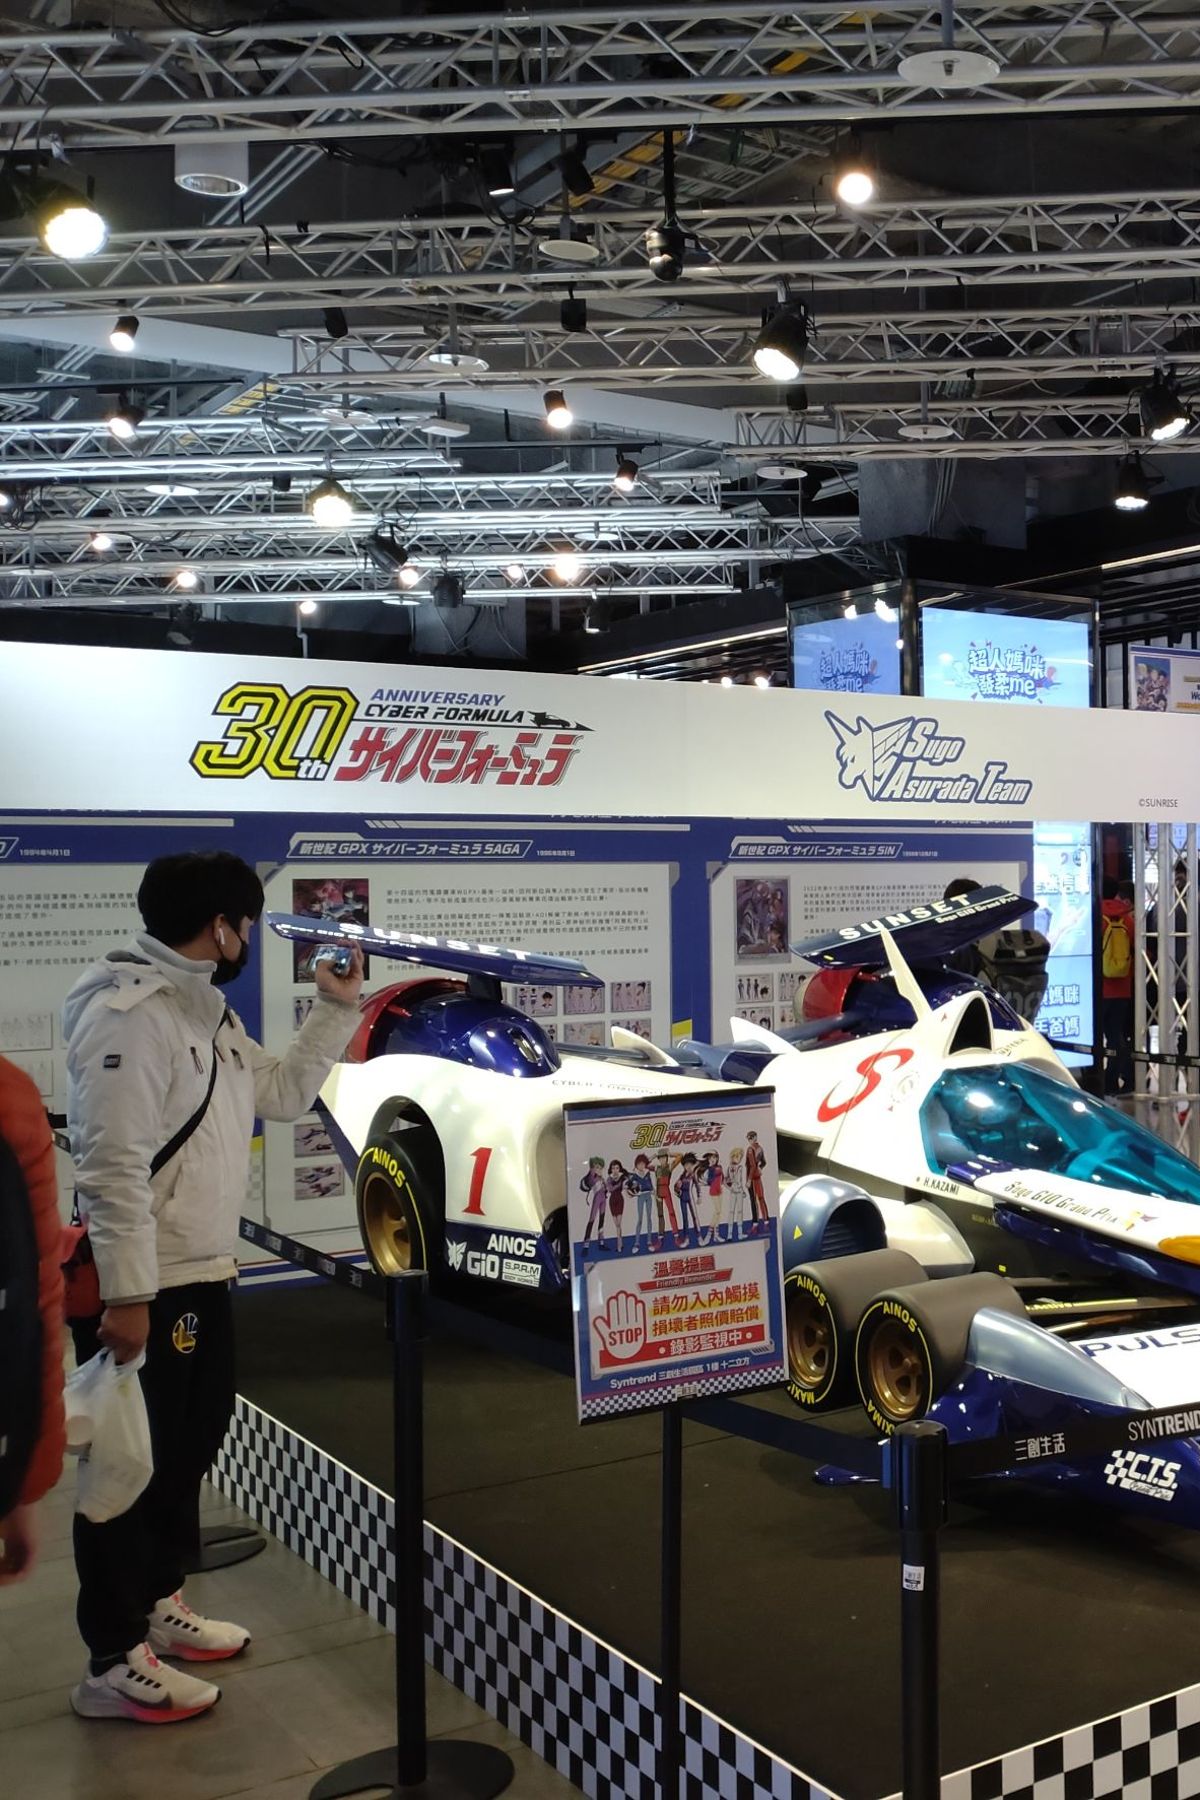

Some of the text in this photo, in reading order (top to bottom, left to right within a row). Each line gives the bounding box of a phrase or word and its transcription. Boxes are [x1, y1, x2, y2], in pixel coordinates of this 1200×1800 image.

[968, 648, 1046, 677] 超人媽咪
[370, 688, 505, 707] ANNIVERSARY
[364, 704, 525, 723] CYBER FORMULA
[906, 719, 965, 762] Sugo
[880, 763, 1032, 803] Asurada Team
[338, 843, 367, 855] GPX
[484, 843, 520, 855] SAGA
[767, 845, 790, 855] GPX
[838, 893, 971, 940] SUNSET
[339, 922, 531, 961] SUNSET
[372, 1147, 406, 1188] AINOS
[461, 1146, 493, 1216] 1
[924, 1177, 960, 1195] H.KAZAMI
[487, 1233, 537, 1258] AINOS
[656, 1276, 682, 1290] Friendly
[797, 1275, 827, 1307] AINOS
[652, 1282, 760, 1316] 請勿入內觸摸
[652, 1306, 761, 1337] 損壞者照價賠償
[882, 1301, 917, 1333] AINOS
[609, 1327, 642, 1346] STOP
[670, 1332, 742, 1356] 錄影監視中
[610, 1372, 657, 1389] Syntrend
[1015, 1433, 1065, 1461] 三創生活
[1128, 1453, 1181, 1490] C.T.S.
